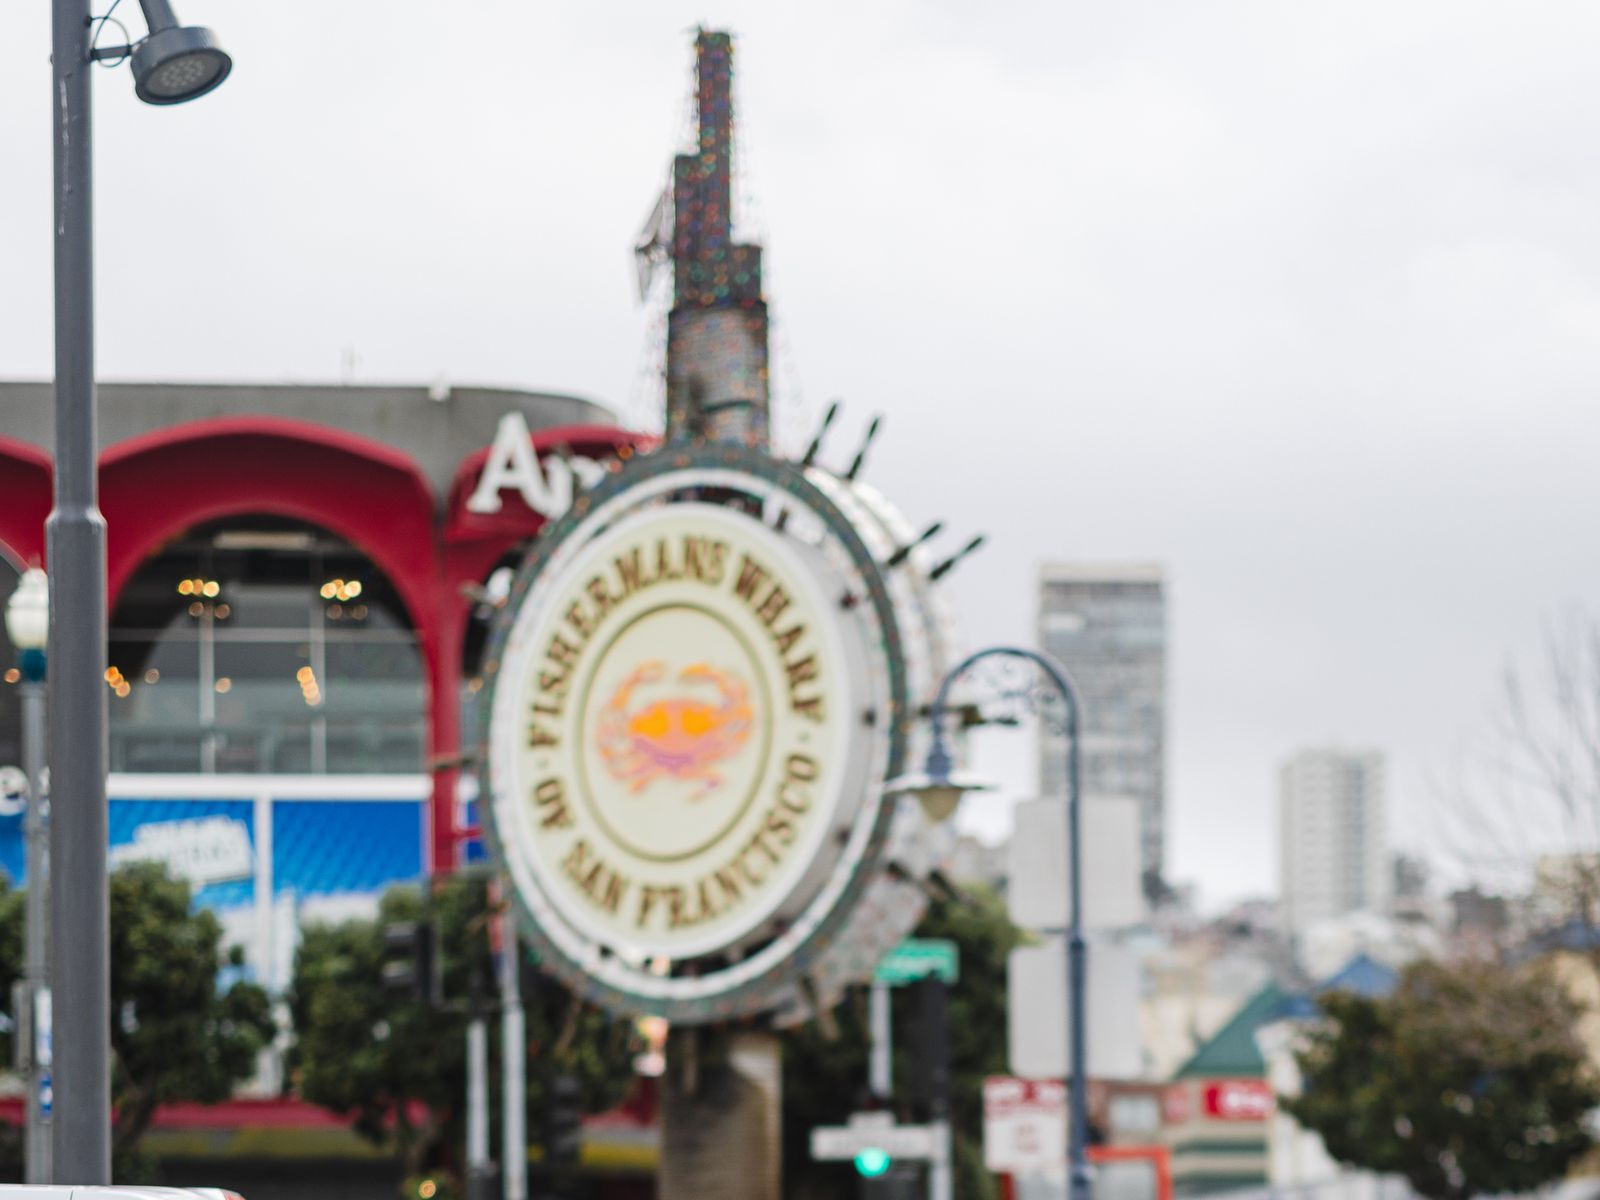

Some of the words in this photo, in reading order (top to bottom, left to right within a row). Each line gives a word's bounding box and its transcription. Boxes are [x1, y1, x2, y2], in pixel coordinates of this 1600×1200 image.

[733, 553, 826, 724] WHARF
[533, 777, 574, 831] OF
[562, 840, 630, 916] SAN
[634, 752, 819, 930] FRANCISCO
